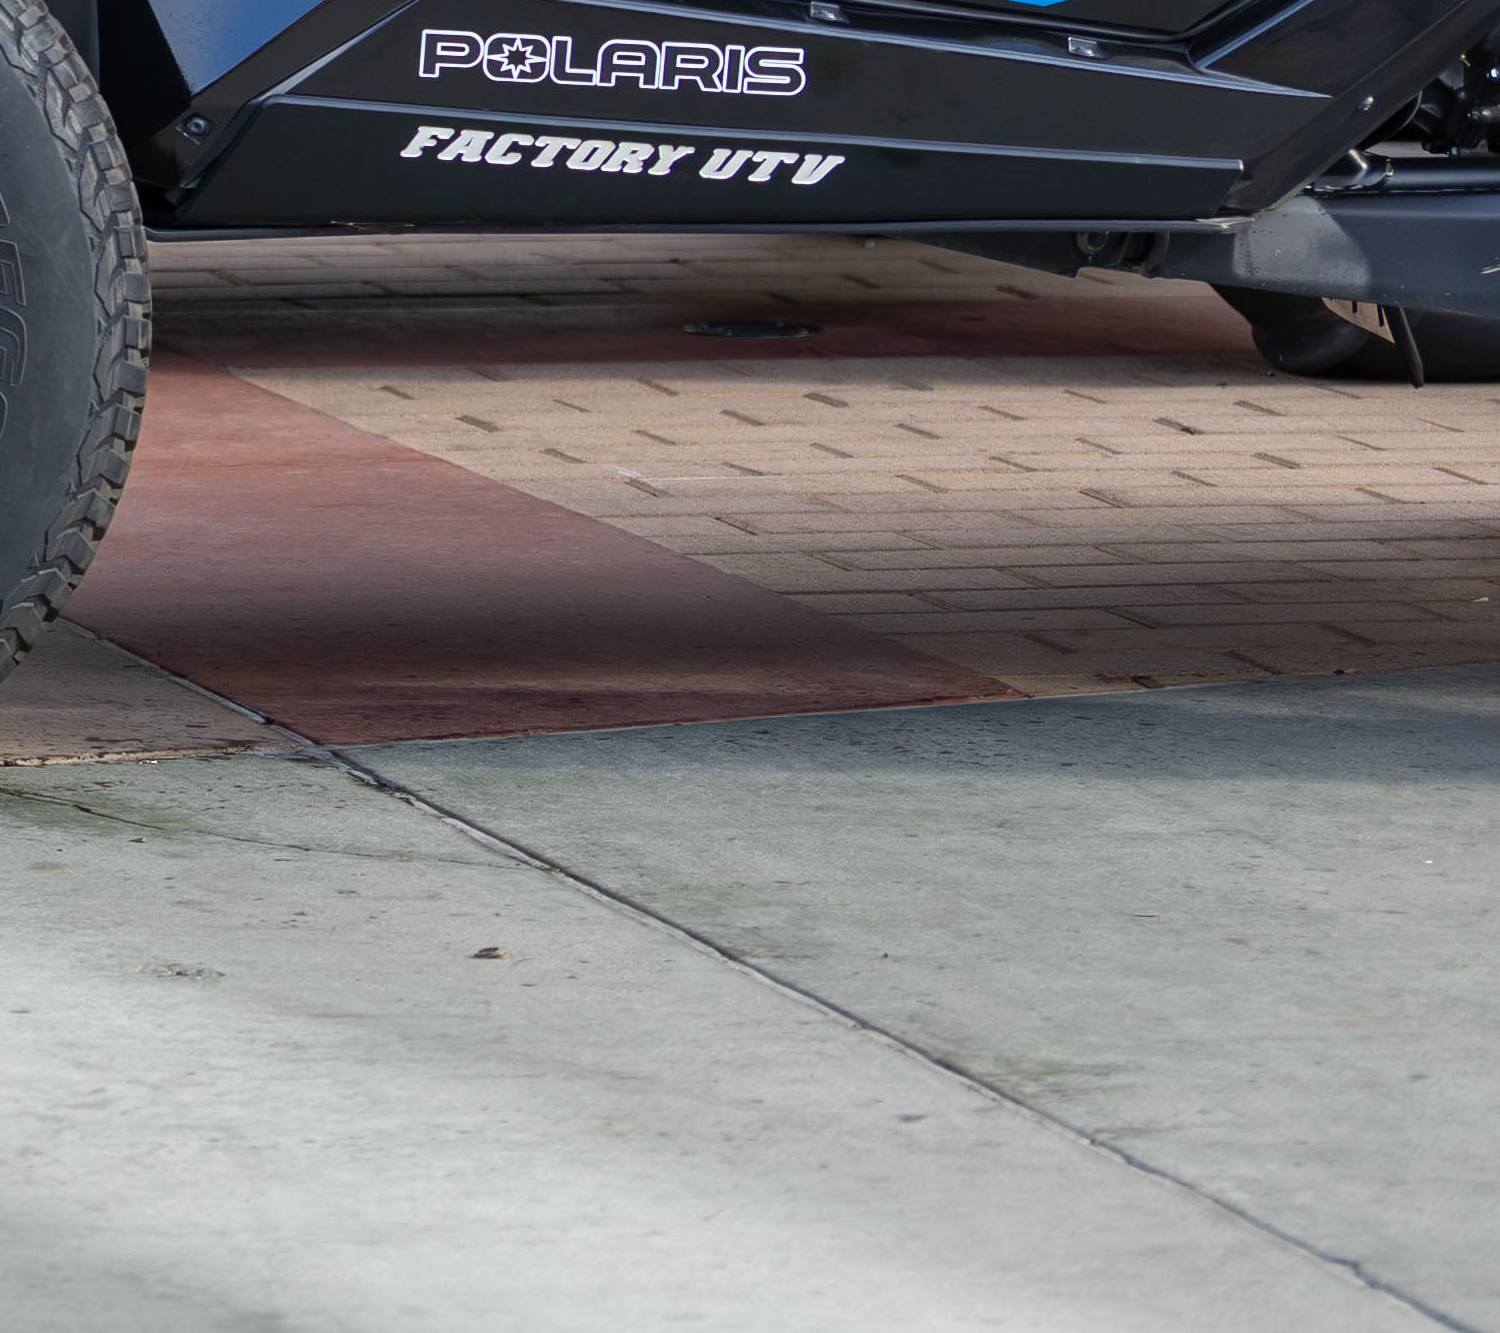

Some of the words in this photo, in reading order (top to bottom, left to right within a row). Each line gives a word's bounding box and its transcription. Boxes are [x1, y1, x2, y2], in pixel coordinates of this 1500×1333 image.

[419, 29, 806, 97] POLARIS
[400, 125, 695, 176] FACTORY
[698, 148, 846, 184] UTV
